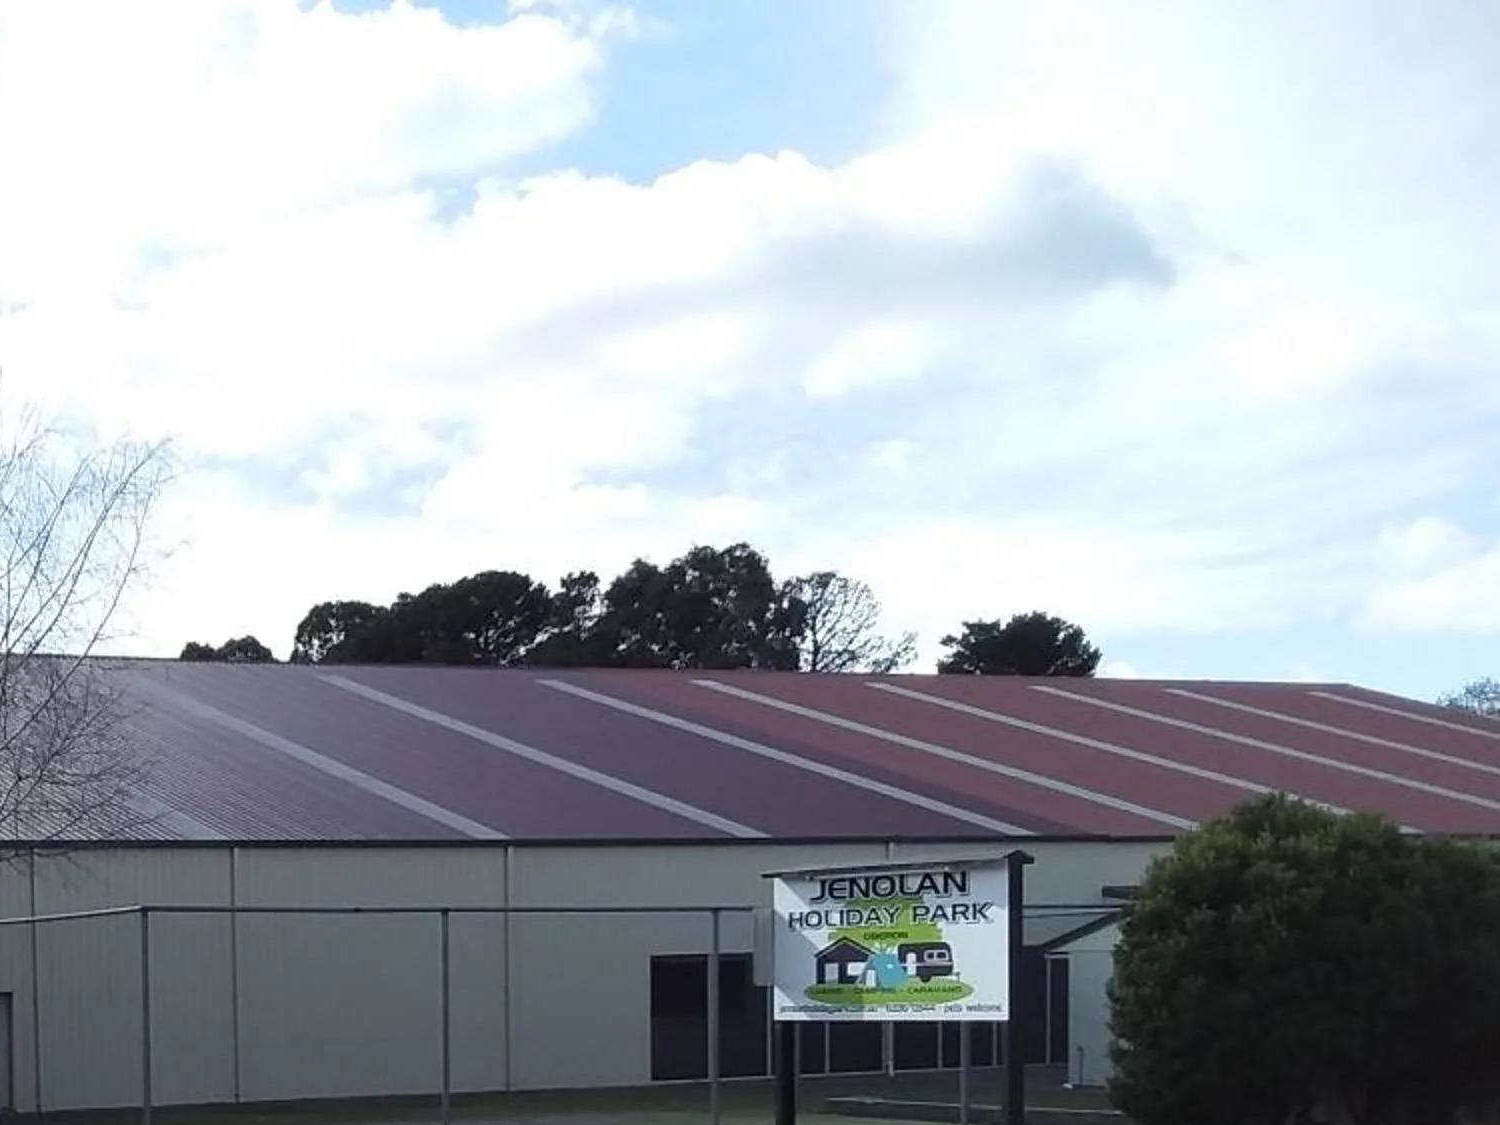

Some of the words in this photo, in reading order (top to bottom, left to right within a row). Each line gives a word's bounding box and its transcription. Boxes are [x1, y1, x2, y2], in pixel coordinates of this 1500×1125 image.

[810, 870, 970, 901] JENOLAN
[787, 906, 902, 930] HOLIDAY
[911, 900, 996, 924] PARK
